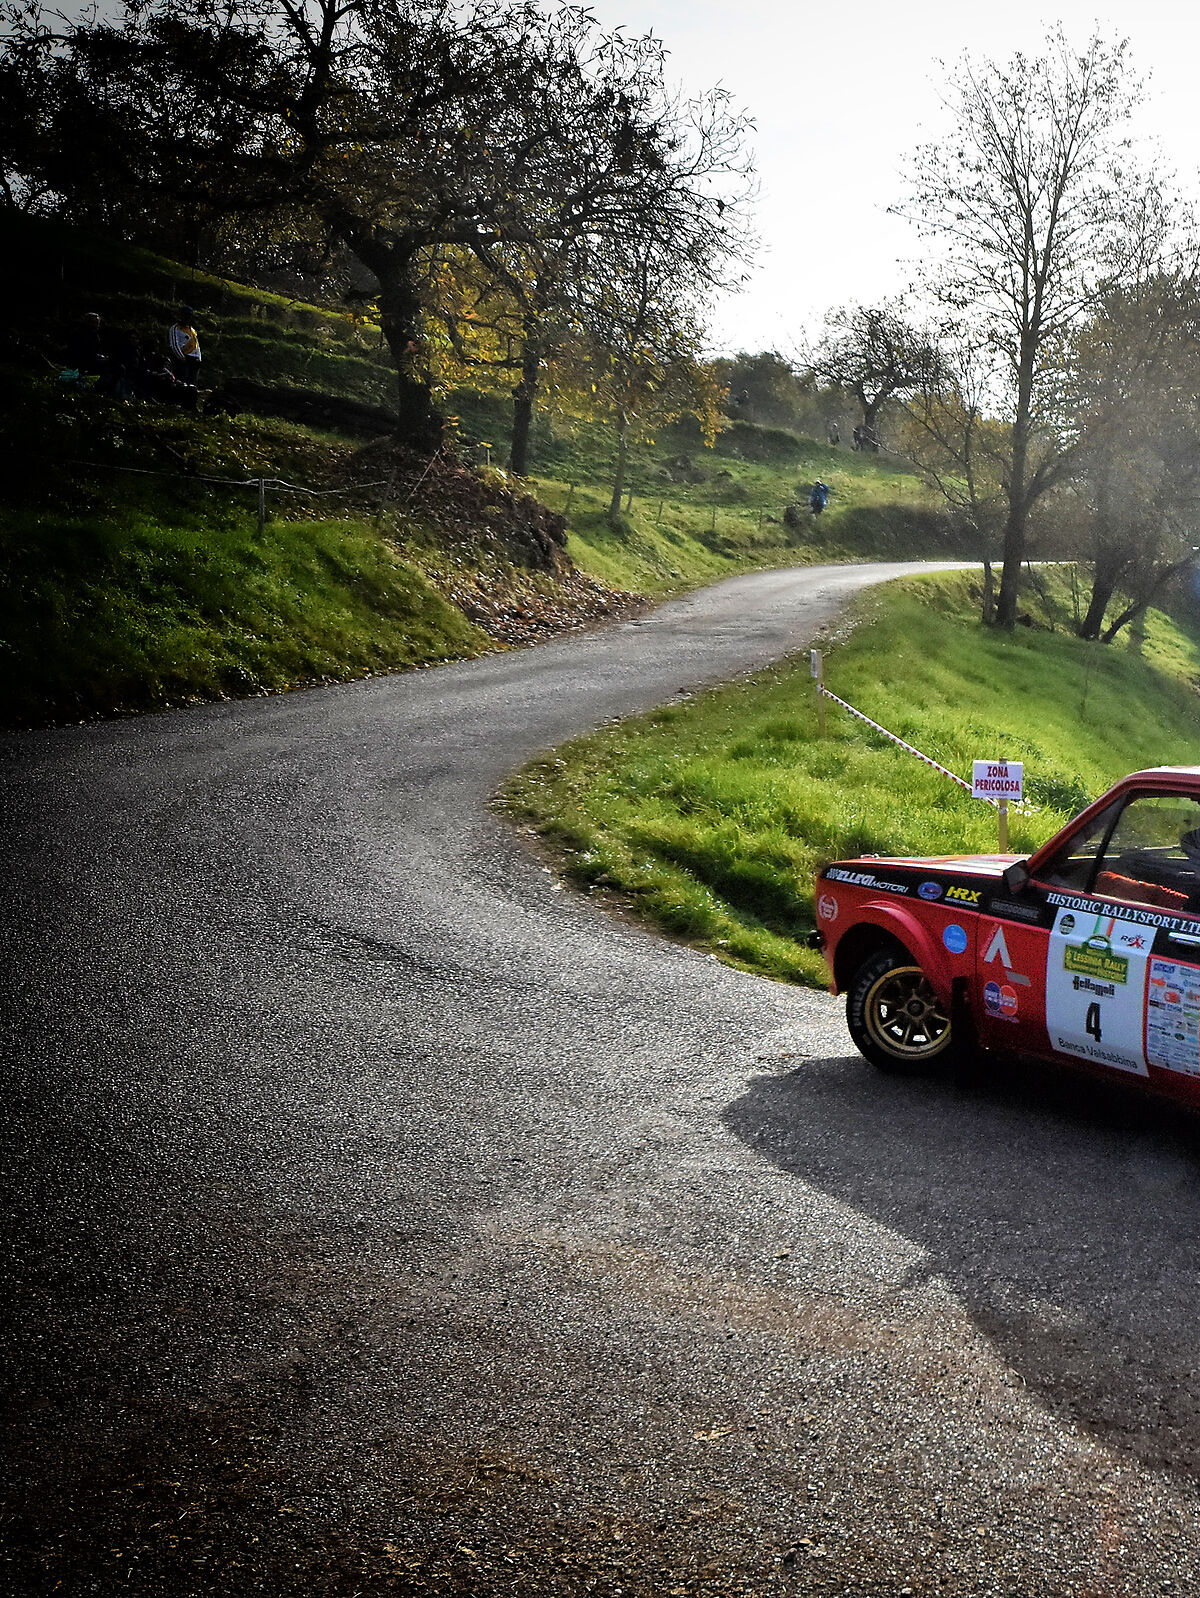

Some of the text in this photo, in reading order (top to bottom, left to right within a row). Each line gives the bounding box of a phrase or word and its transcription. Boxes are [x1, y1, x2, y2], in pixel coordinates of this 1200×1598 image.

[987, 766, 1009, 778] ZONA
[975, 779, 1020, 792] PERICOLOSA
[872, 880, 909, 893] MOTORI
[946, 886, 982, 903] HRX
[1046, 893, 1101, 914] HISTORIC
[1101, 904, 1179, 930] RALLYSPORT
[1085, 1001, 1102, 1043] 4
[1058, 1037, 1138, 1069] Banca Valsabbina
